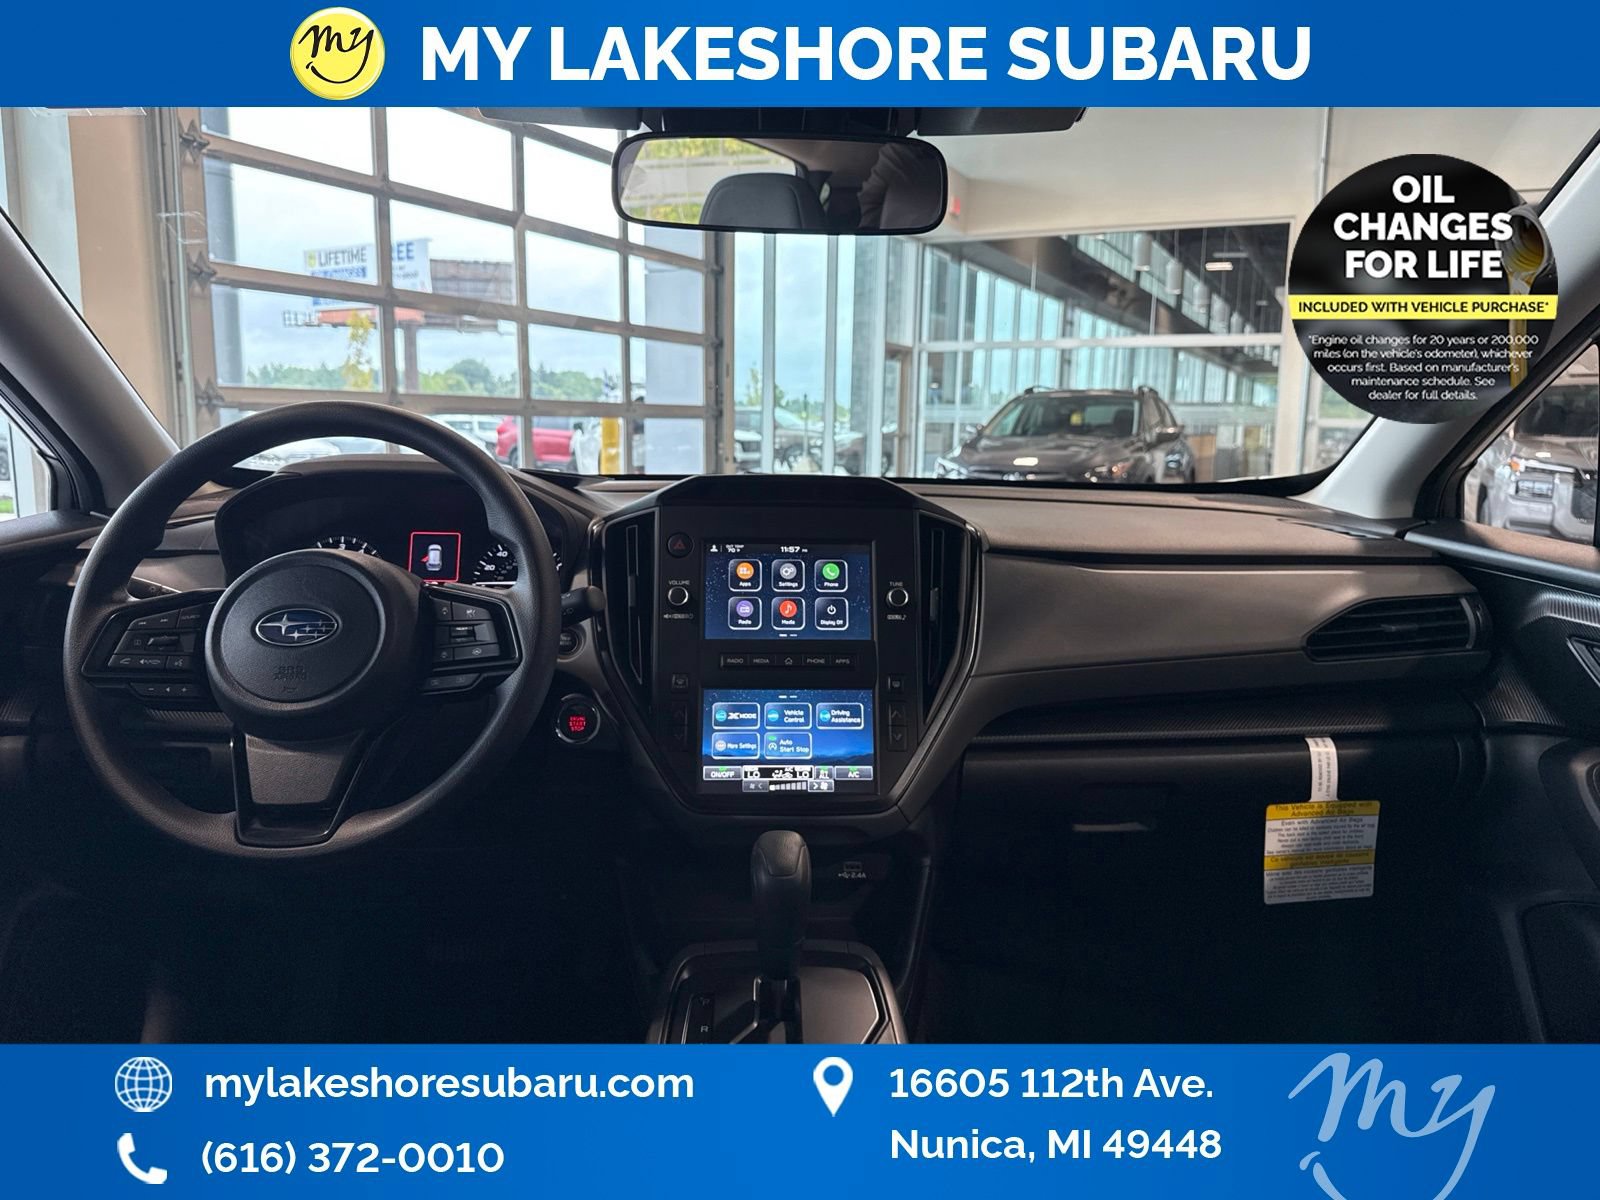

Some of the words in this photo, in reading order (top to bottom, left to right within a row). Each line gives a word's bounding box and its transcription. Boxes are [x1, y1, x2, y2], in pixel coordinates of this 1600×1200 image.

[319, 247, 367, 267] LIFETIME
[780, 545, 801, 553] 11:57
[820, 619, 836, 627] Display
[783, 709, 805, 717] Vehicle
[830, 709, 850, 717] Driving
[739, 742, 757, 751] Settings
[710, 770, 735, 779] ON/OFF
[747, 771, 761, 779] LO
[796, 771, 810, 779] LO
[1291, 803, 1315, 811] Vehicle
[700, 1025, 709, 1033] R
